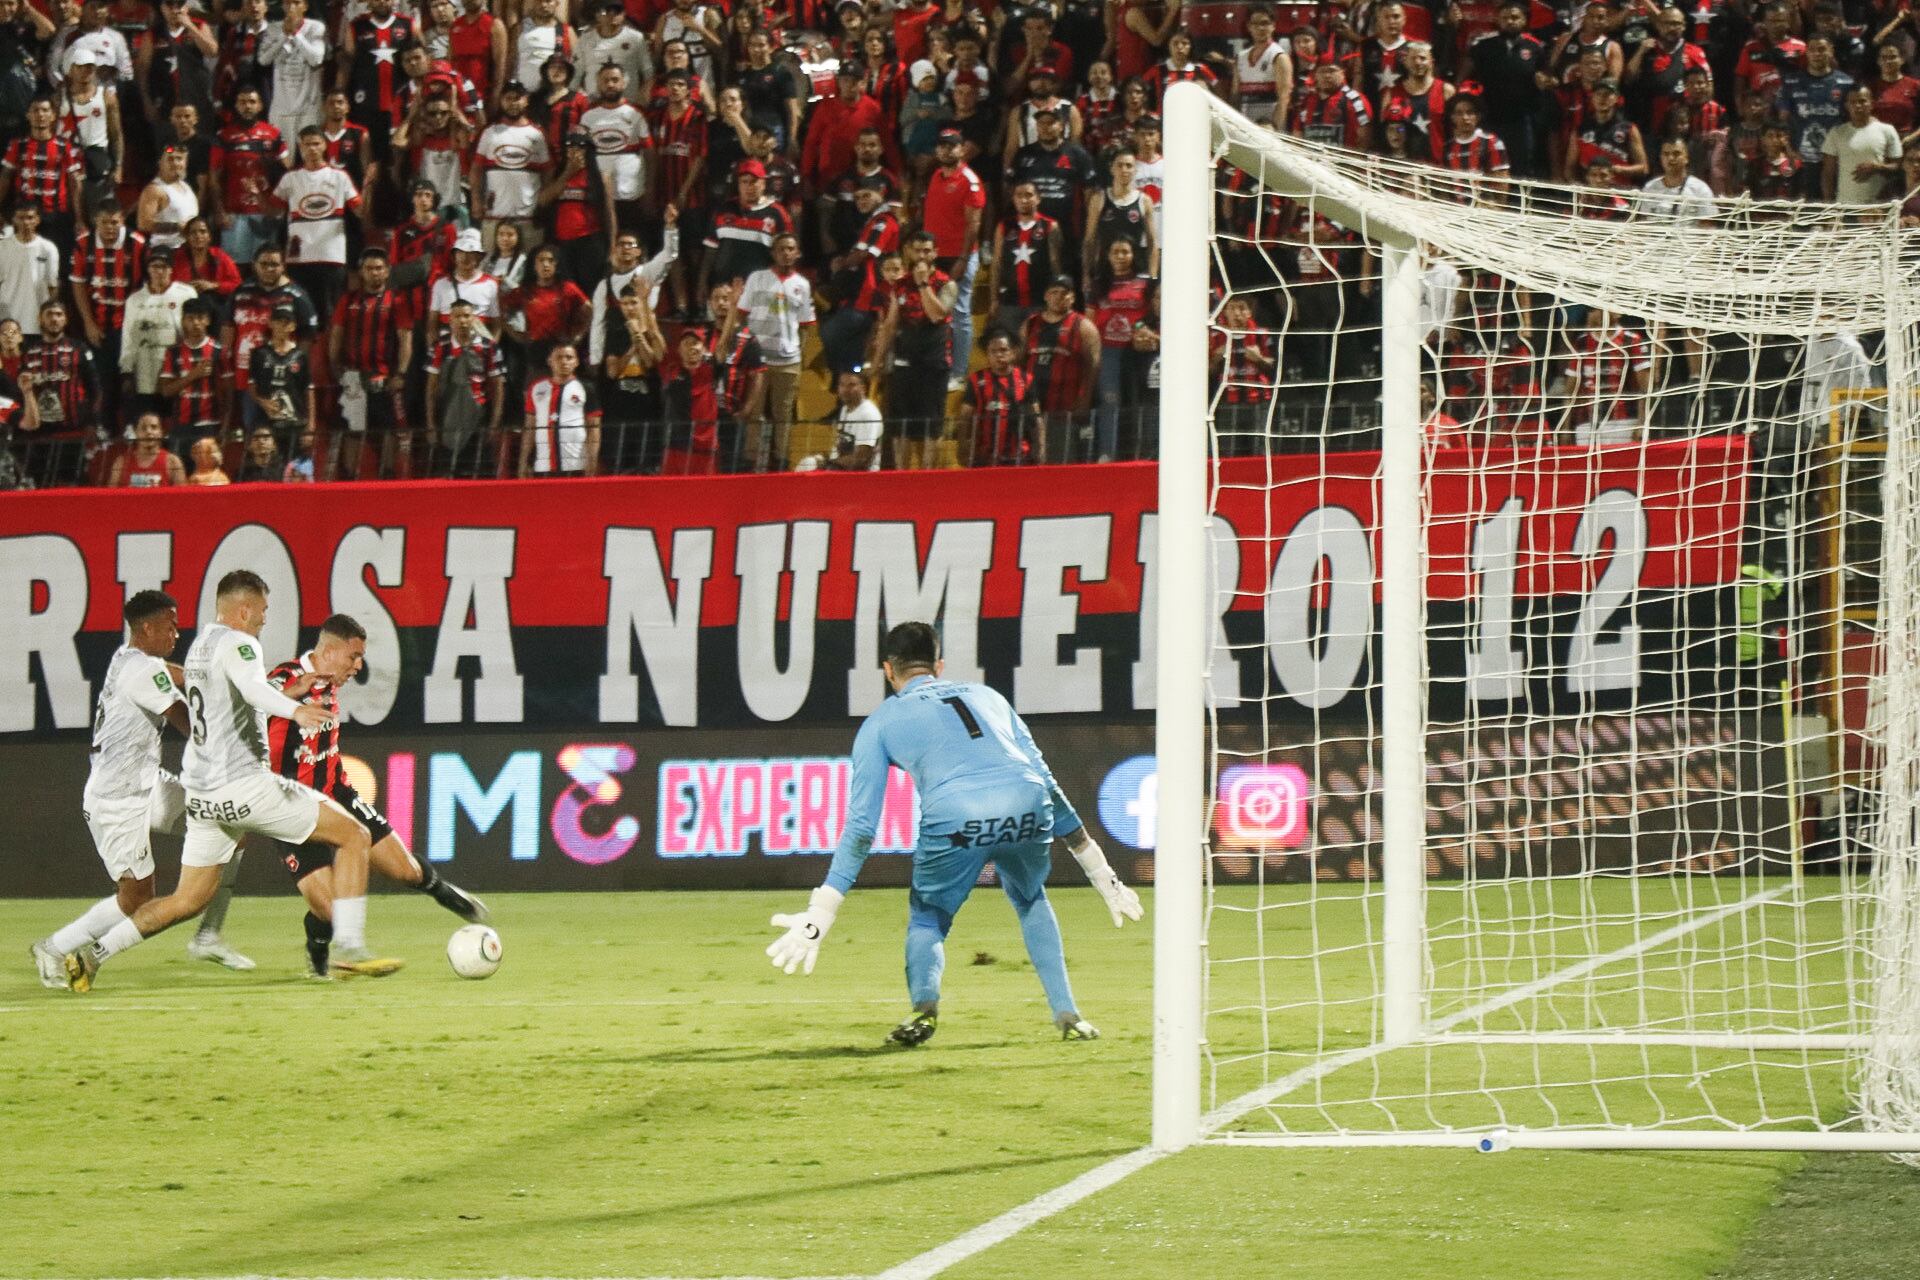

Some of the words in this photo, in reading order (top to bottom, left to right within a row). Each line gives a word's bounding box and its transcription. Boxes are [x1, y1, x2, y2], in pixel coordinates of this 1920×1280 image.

[598, 505, 1372, 727] NUMERO
[1470, 487, 1648, 700] 12
[941, 696, 984, 740] 1
[662, 762, 915, 852] EXPERIN
[962, 812, 1036, 835] STAR
